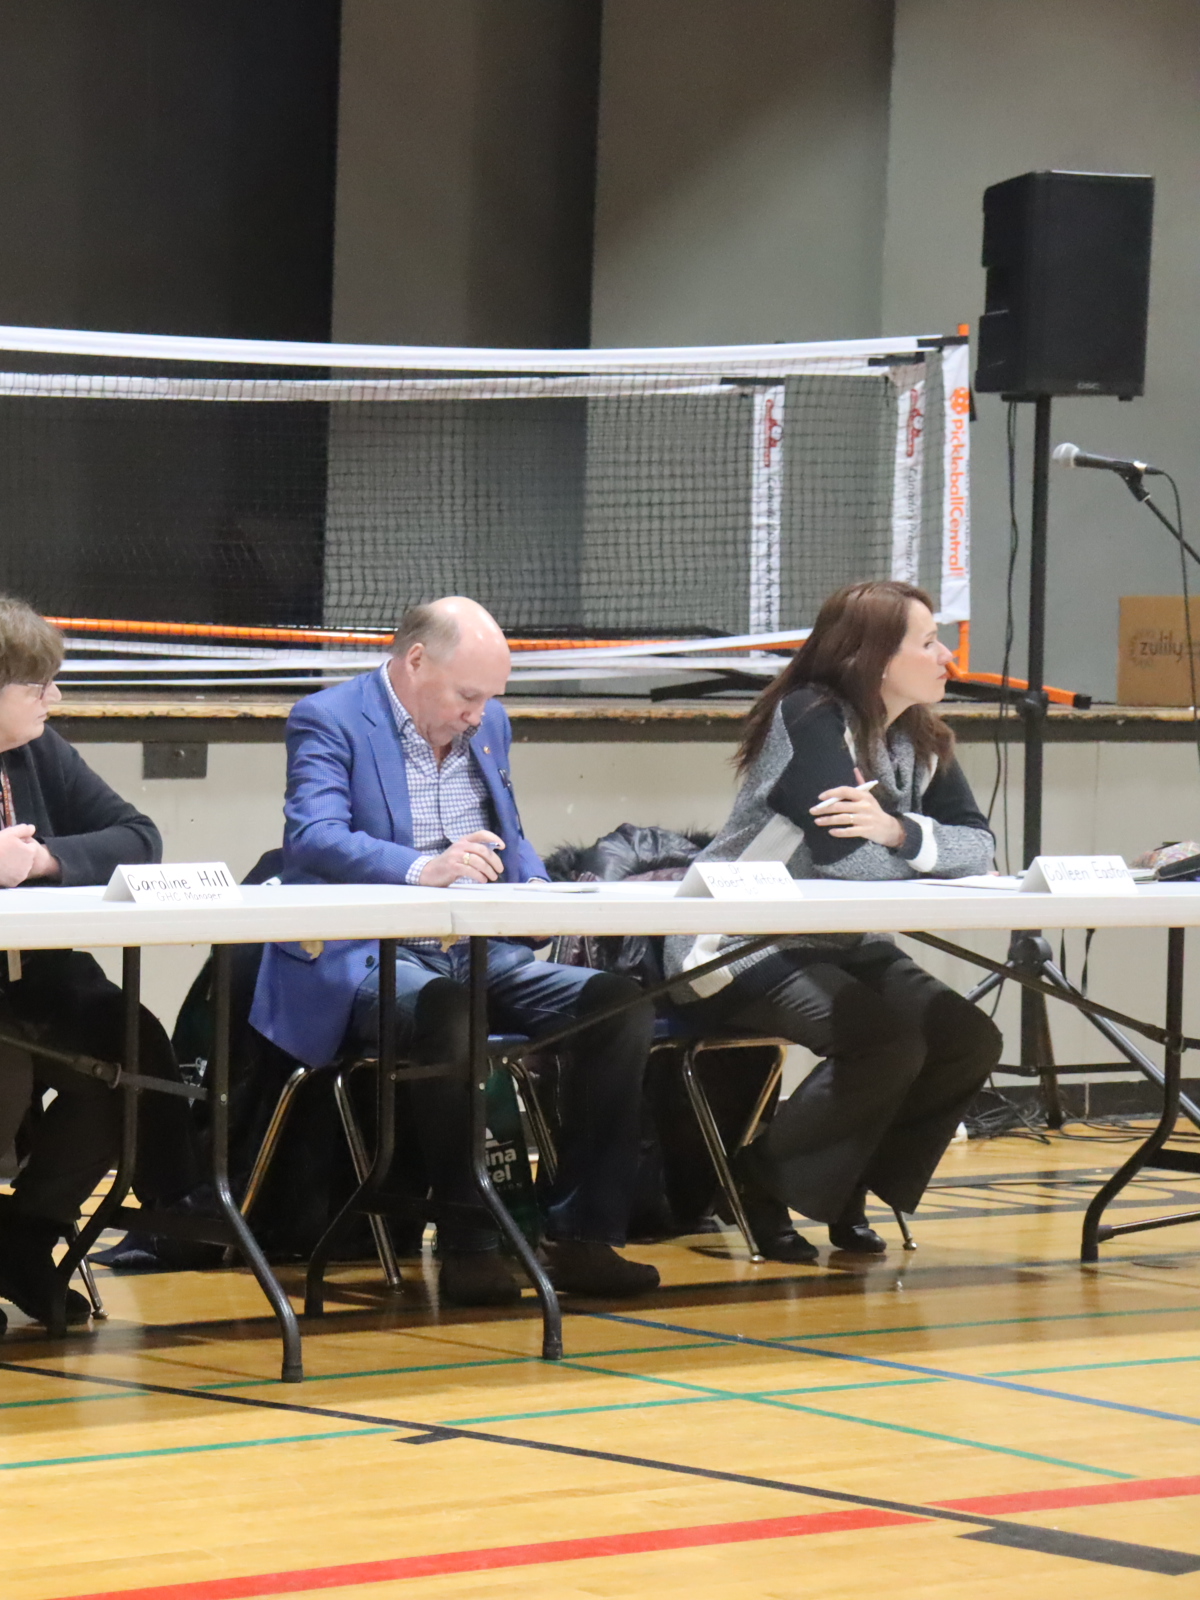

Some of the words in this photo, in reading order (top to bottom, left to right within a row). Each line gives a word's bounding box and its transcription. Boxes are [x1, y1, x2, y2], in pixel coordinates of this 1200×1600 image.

[127, 870, 191, 892] Caroline
[197, 870, 229, 887] Hill
[1043, 862, 1090, 881] Colleen
